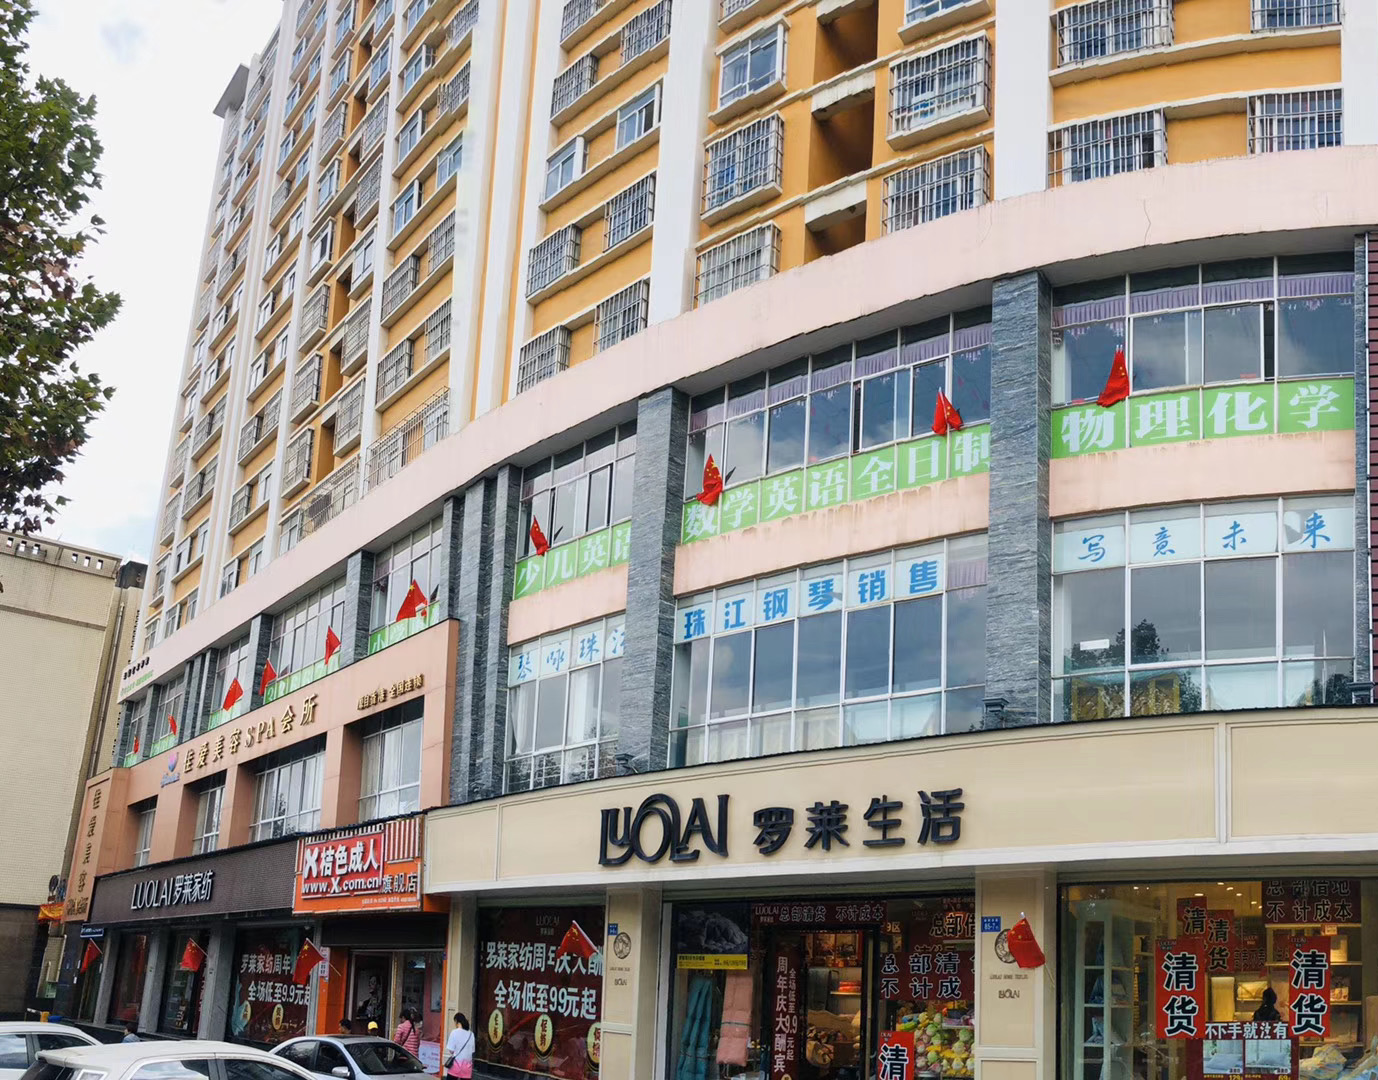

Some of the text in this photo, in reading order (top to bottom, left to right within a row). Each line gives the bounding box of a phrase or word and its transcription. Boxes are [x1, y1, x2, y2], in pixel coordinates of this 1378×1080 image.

[1060, 384, 1341, 453] 物理化学
[683, 431, 991, 544] 数学英语全日制
[1077, 512, 1332, 563] 写意未来
[683, 559, 939, 641] 珠江钢琴销售
[320, 838, 381, 877] 桔色成人
[599, 793, 730, 867] LUOLAI
[752, 788, 964, 856] 罗莱生活
[131, 875, 174, 910] LUOLAI
[172, 869, 214, 906] 罗莱家纺
[302, 876, 380, 894] www.X.com.cn
[774, 956, 788, 1073] 周年庆大酬宾
[1161, 951, 1198, 1037] 清货
[1290, 949, 1328, 1037] 清货
